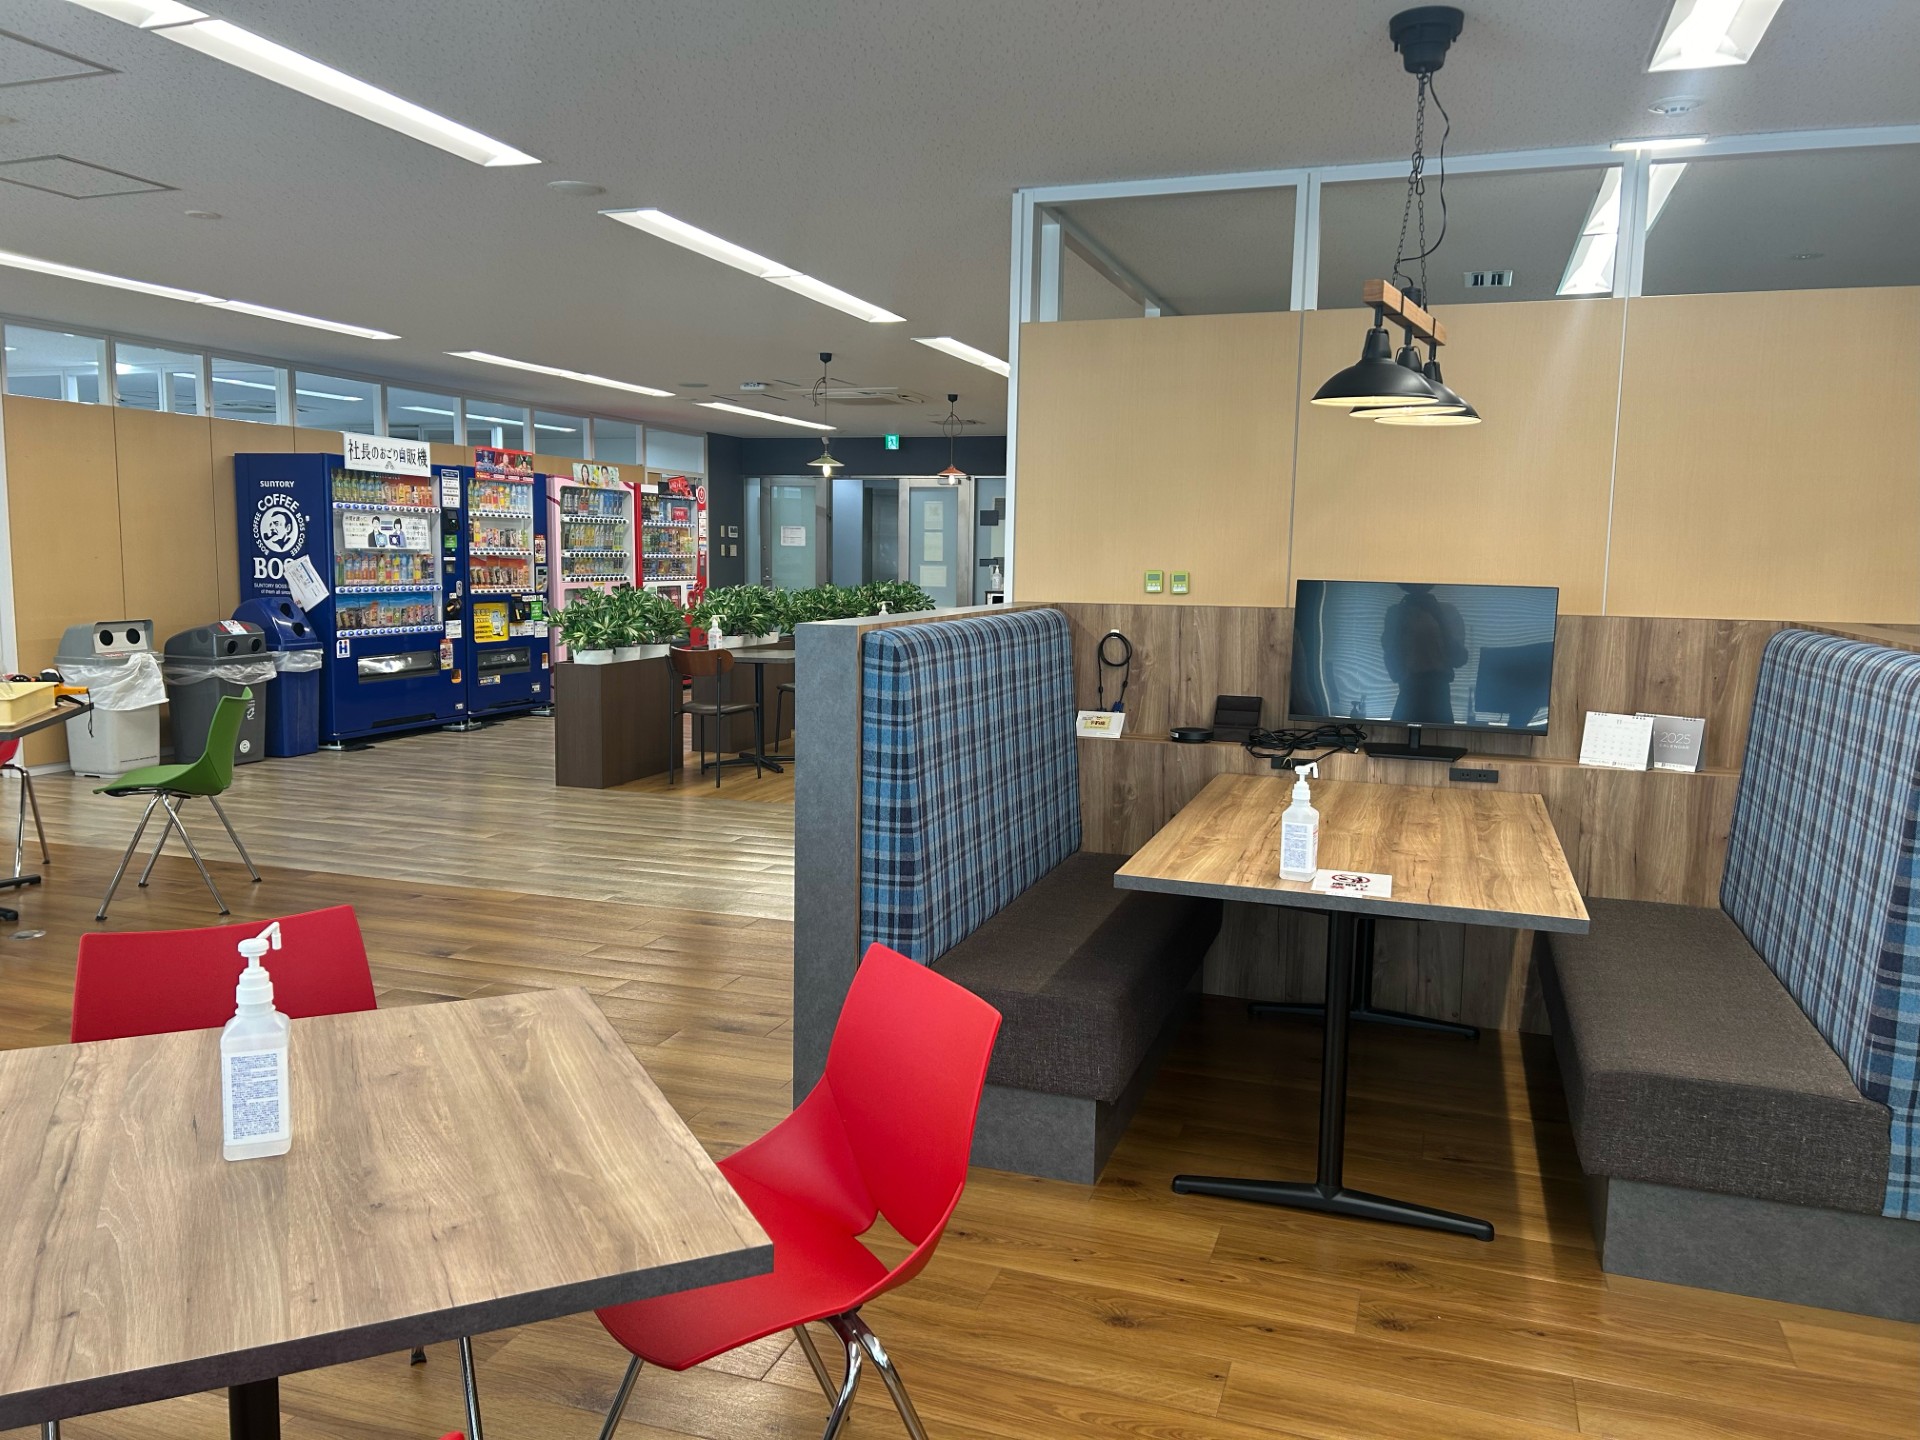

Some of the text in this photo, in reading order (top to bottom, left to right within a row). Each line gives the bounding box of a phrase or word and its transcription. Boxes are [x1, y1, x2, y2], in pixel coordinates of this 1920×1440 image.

[348, 438, 428, 468] 社長のおごり自販機
[260, 480, 295, 488] SUNTORY
[257, 493, 300, 512] COFFEE
[252, 511, 262, 539] COFFEE
[291, 512, 306, 557] BOSS COFFEE
[1660, 731, 1691, 744] 2025
